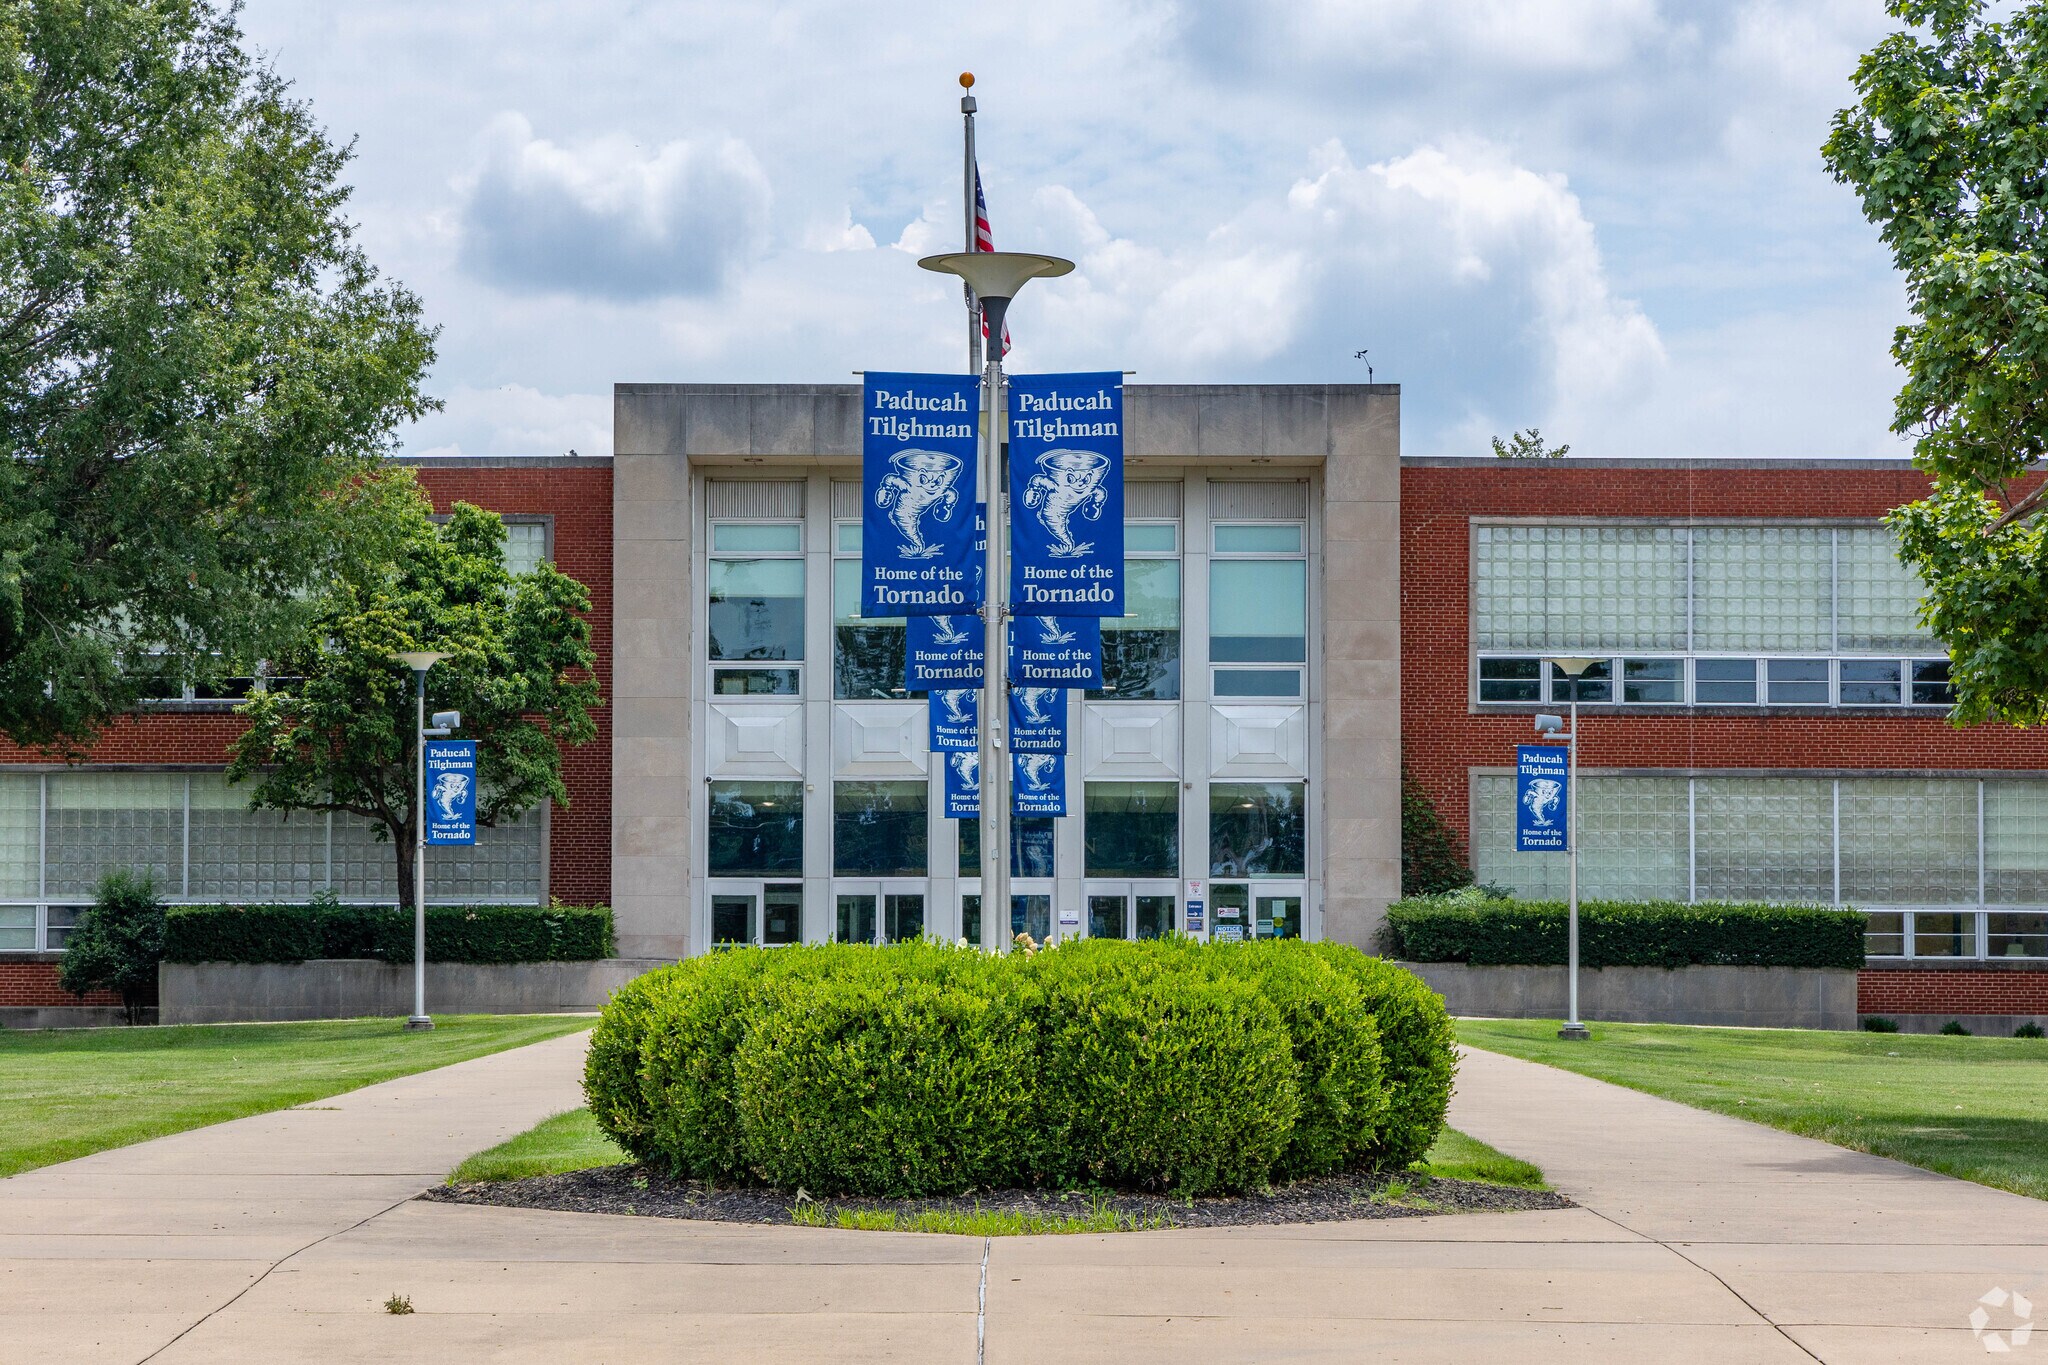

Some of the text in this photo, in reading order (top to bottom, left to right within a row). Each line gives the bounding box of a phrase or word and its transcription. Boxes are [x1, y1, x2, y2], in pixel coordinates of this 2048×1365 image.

[875, 390, 967, 411] Paducah
[1019, 390, 1112, 411] Paducah
[869, 416, 972, 441] Tilghman
[1014, 418, 1118, 442] Tilghman
[875, 566, 963, 580] Home of the
[1023, 565, 1113, 579] Home of the
[874, 584, 964, 604] Tornado
[1023, 582, 1114, 602] Tornado
[915, 649, 984, 661] Home of the
[1022, 650, 1056, 661] Home
[1057, 649, 1071, 661] of
[1071, 649, 1092, 661] the
[915, 663, 983, 678] Tornado
[1022, 663, 1092, 678] Tornado
[936, 725, 978, 735] Home of th
[1014, 727, 1062, 736] Home of the
[1013, 737, 1061, 749] Tornado
[430, 748, 471, 758] Paducah
[1522, 754, 1563, 764] Paducah
[427, 760, 473, 771] Tilghman
[1519, 765, 1565, 777] Tilghman
[950, 802, 979, 812] Torna
[1017, 802, 1061, 812] Tornado
[431, 830, 471, 839] Tornado
[1522, 837, 1563, 846] Tornado
